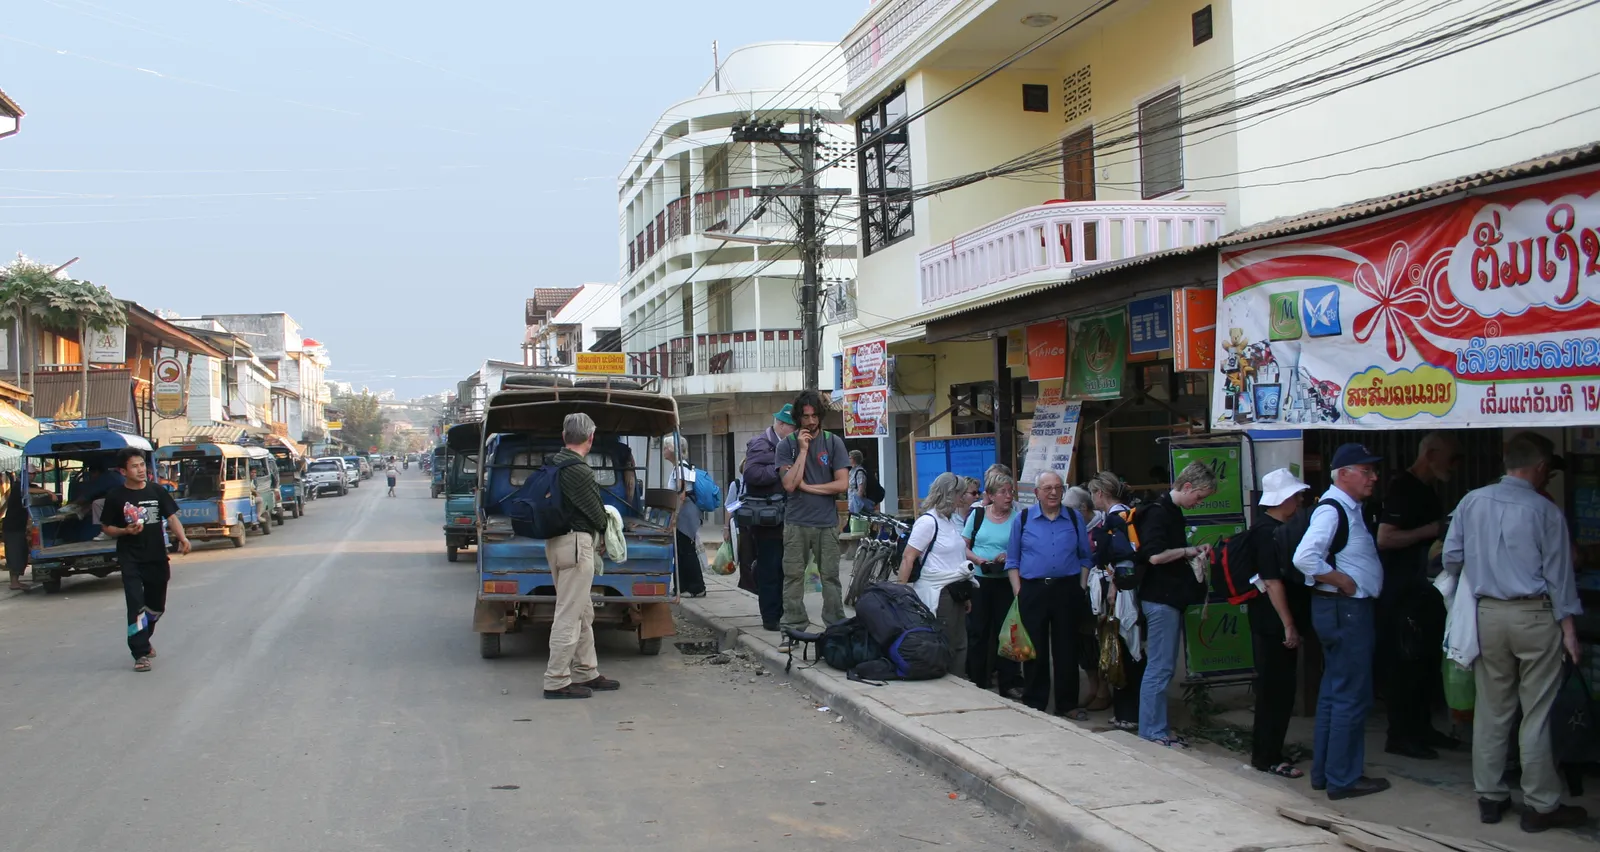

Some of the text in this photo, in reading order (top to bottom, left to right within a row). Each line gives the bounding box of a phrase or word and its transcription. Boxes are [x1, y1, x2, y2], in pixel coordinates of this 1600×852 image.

[1131, 312, 1167, 341] ETL
[1029, 341, 1065, 356] TANGO
[176, 508, 209, 517] SUZU
[1202, 655, 1242, 665] M-PHONE
